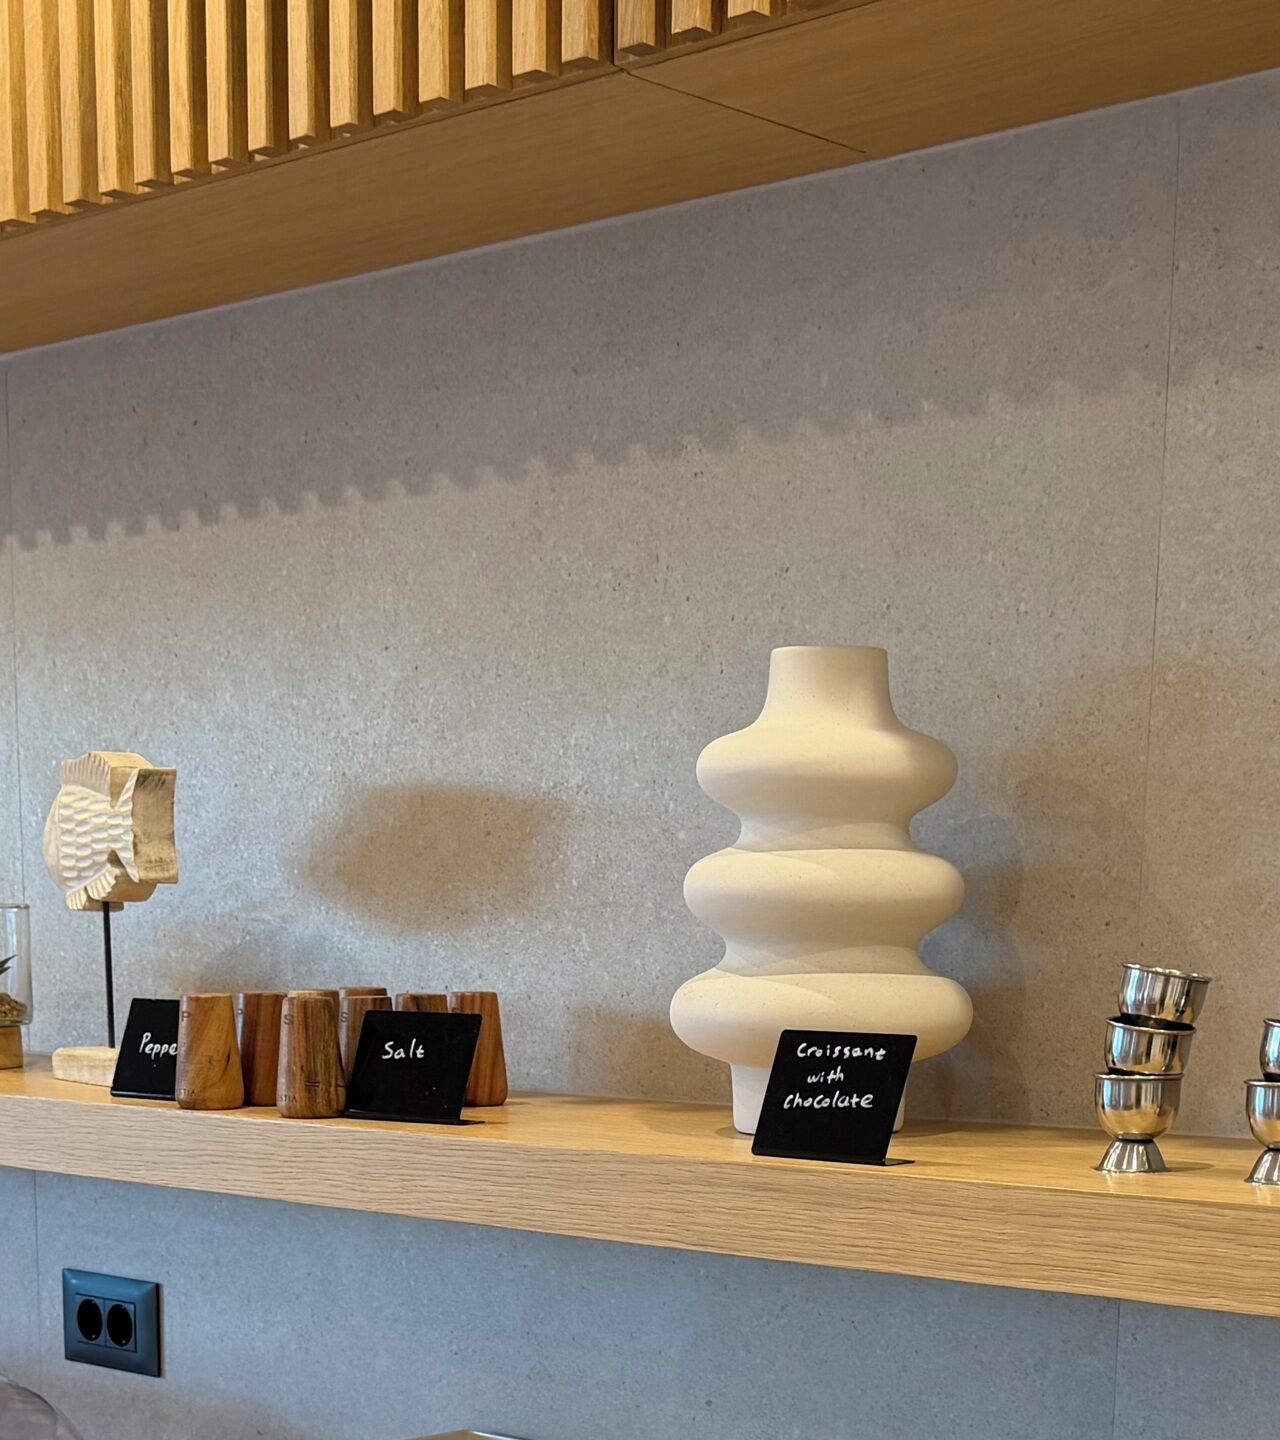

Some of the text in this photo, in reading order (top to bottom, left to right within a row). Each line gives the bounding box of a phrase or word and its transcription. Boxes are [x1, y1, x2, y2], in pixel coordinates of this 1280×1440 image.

[138, 1031, 178, 1060] Peppe
[381, 1037, 425, 1060] Salt
[796, 1042, 887, 1061] Croissant
[806, 1065, 845, 1085] with
